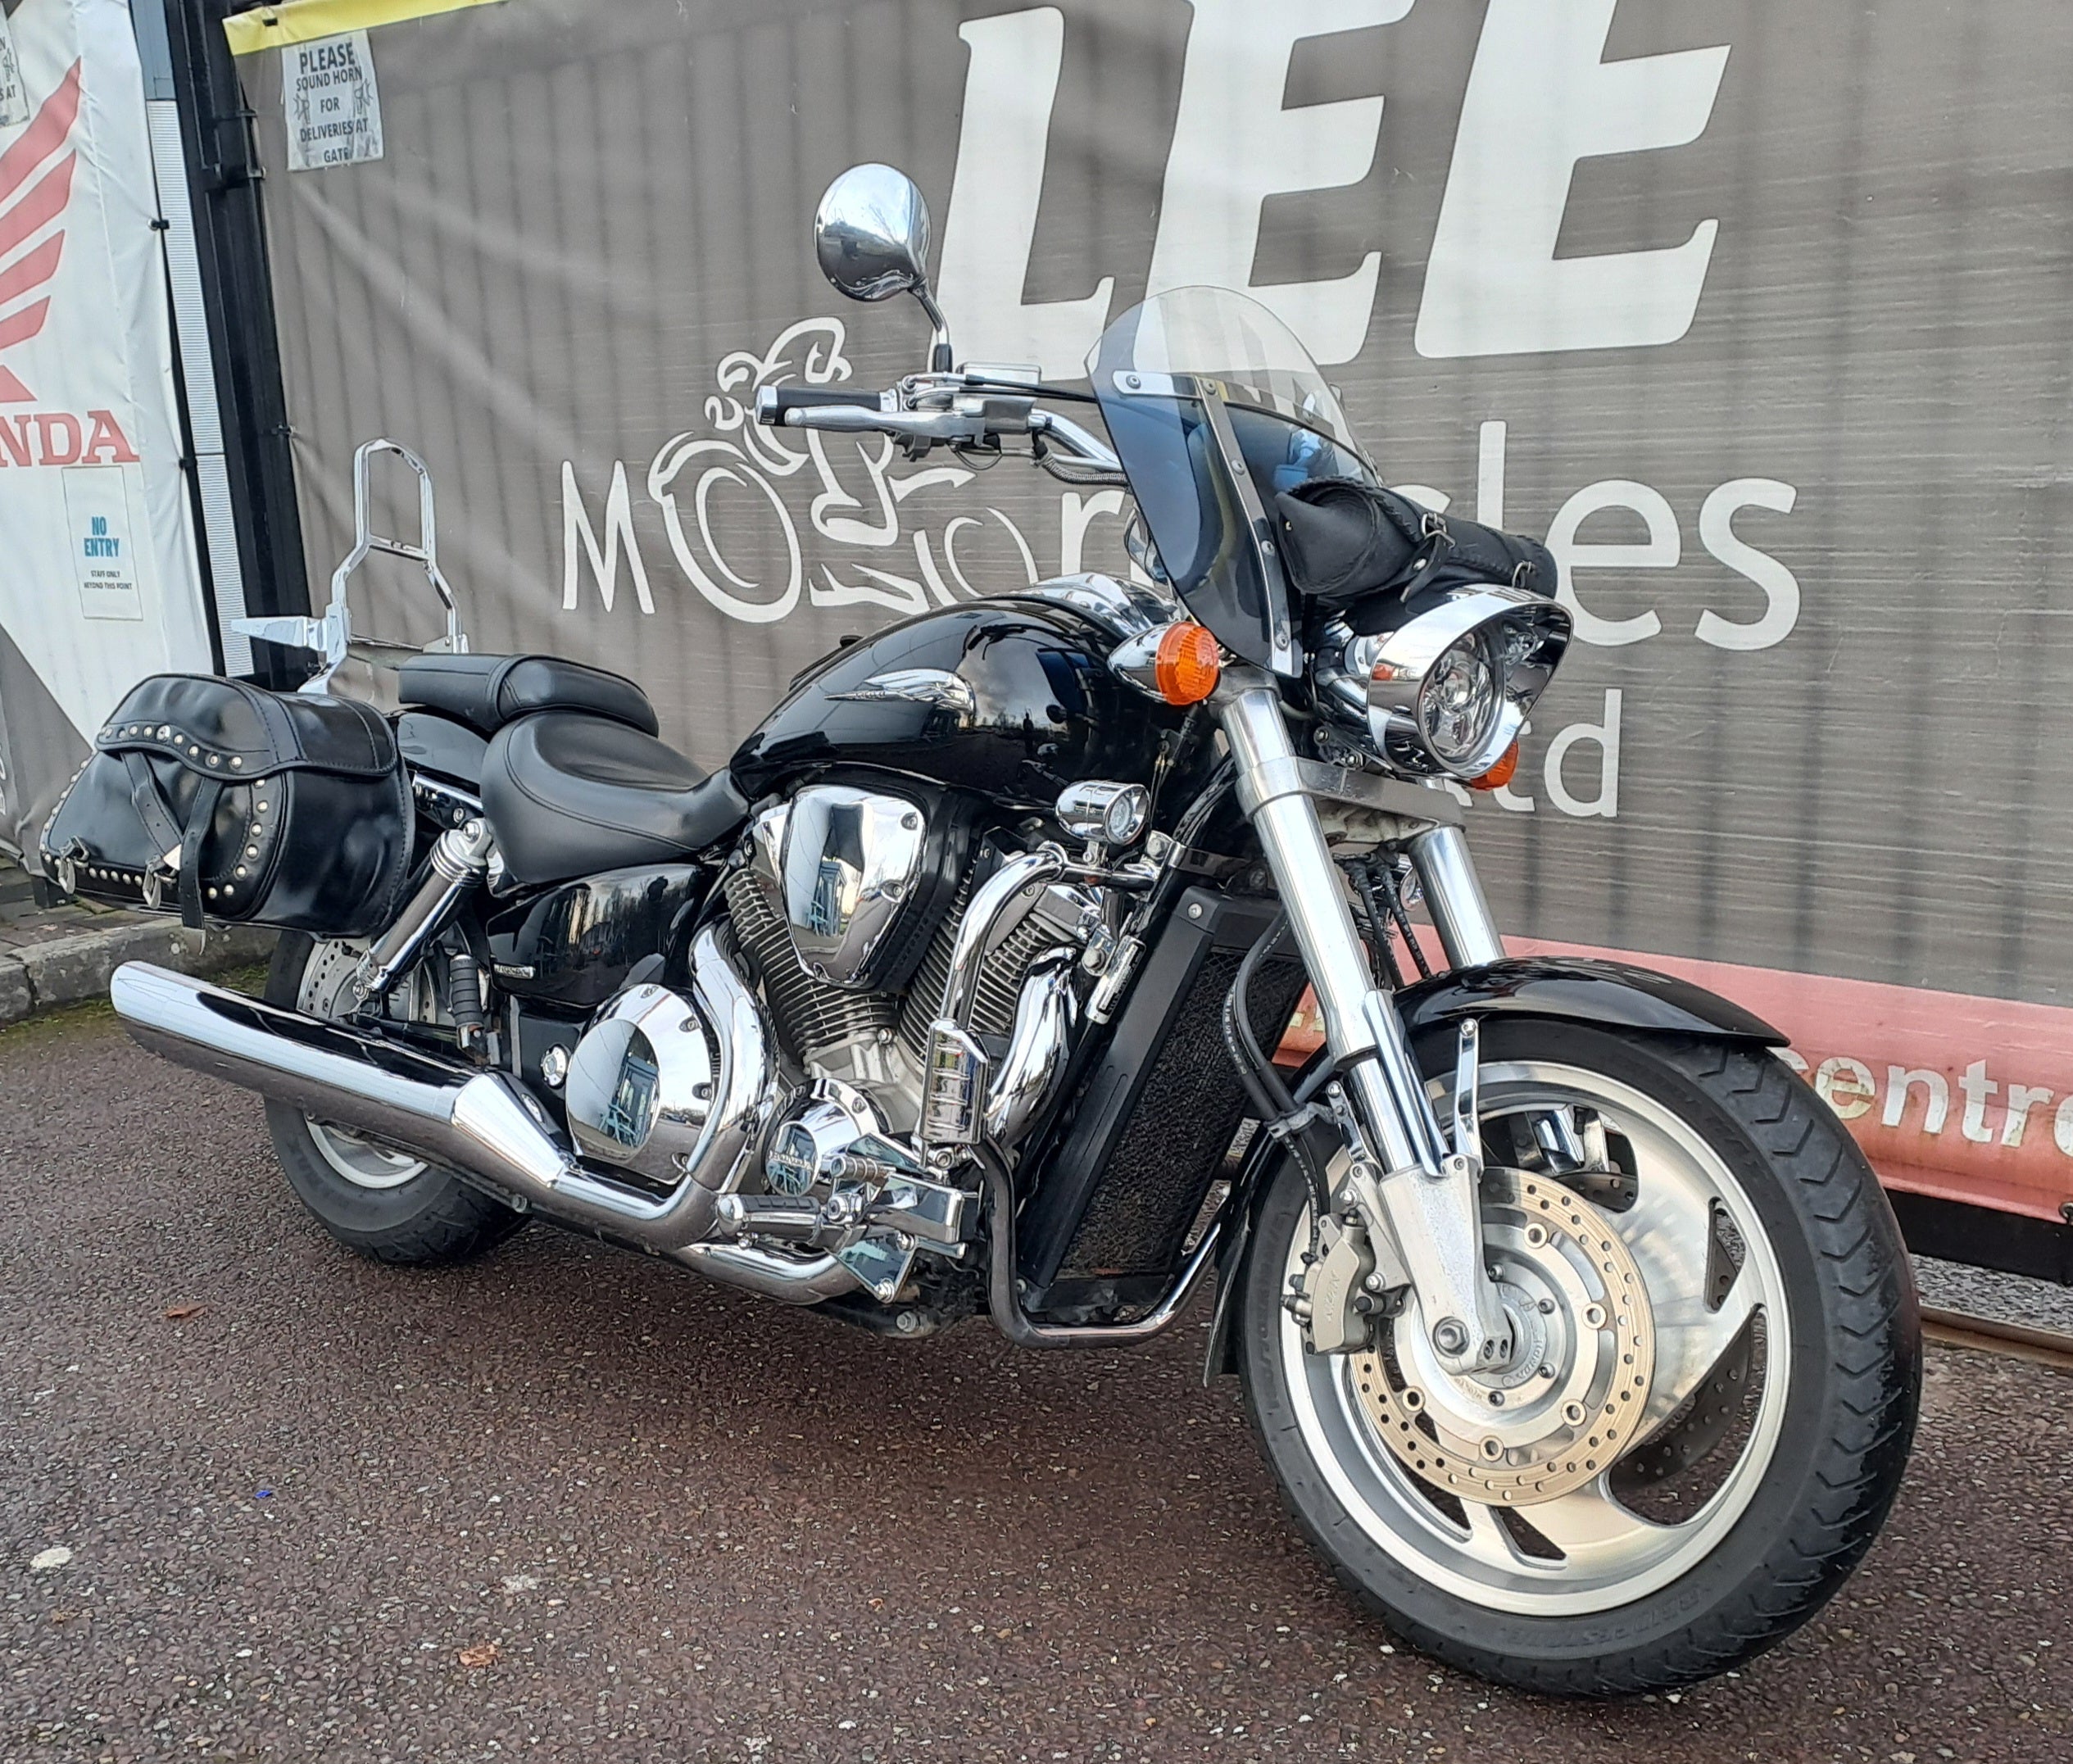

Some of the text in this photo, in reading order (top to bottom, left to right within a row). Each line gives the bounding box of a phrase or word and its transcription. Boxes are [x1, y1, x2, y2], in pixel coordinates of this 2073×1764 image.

[299, 41, 356, 75] PLEASE
[296, 66, 363, 92] SOUND HORN
[7, 84, 16, 100] AT
[320, 96, 341, 114] FOR
[299, 117, 369, 143] DELIVERIES AT
[323, 146, 350, 163] GATE
[928, 0, 1731, 383] LEE
[91, 515, 107, 536] NO
[84, 537, 120, 557] ENTRY
